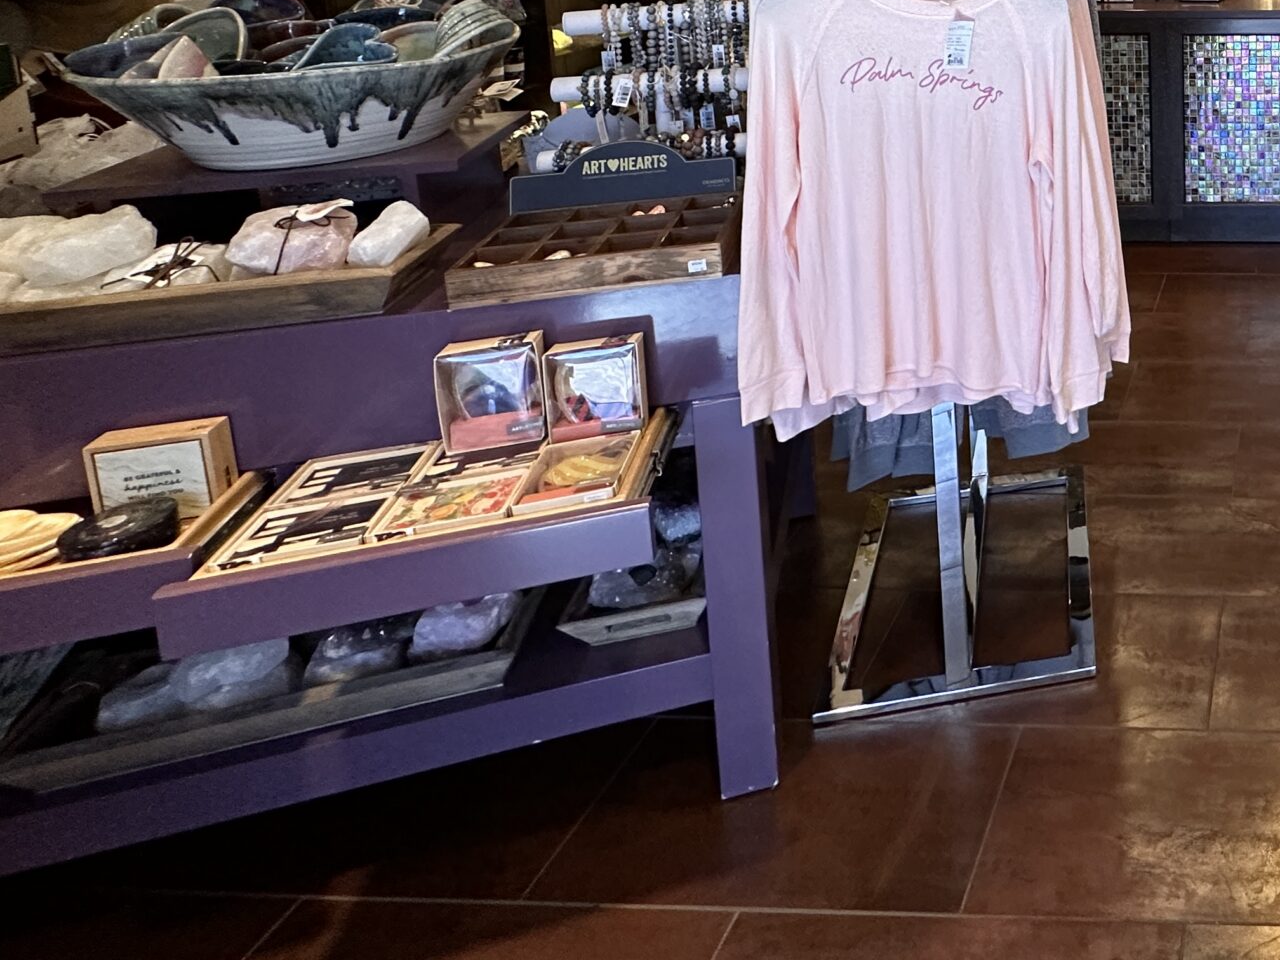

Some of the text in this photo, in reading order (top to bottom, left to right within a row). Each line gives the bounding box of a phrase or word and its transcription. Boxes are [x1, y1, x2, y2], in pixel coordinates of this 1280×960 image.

[840, 56, 1004, 111] Palm Springs
[124, 478, 184, 492] happiness
